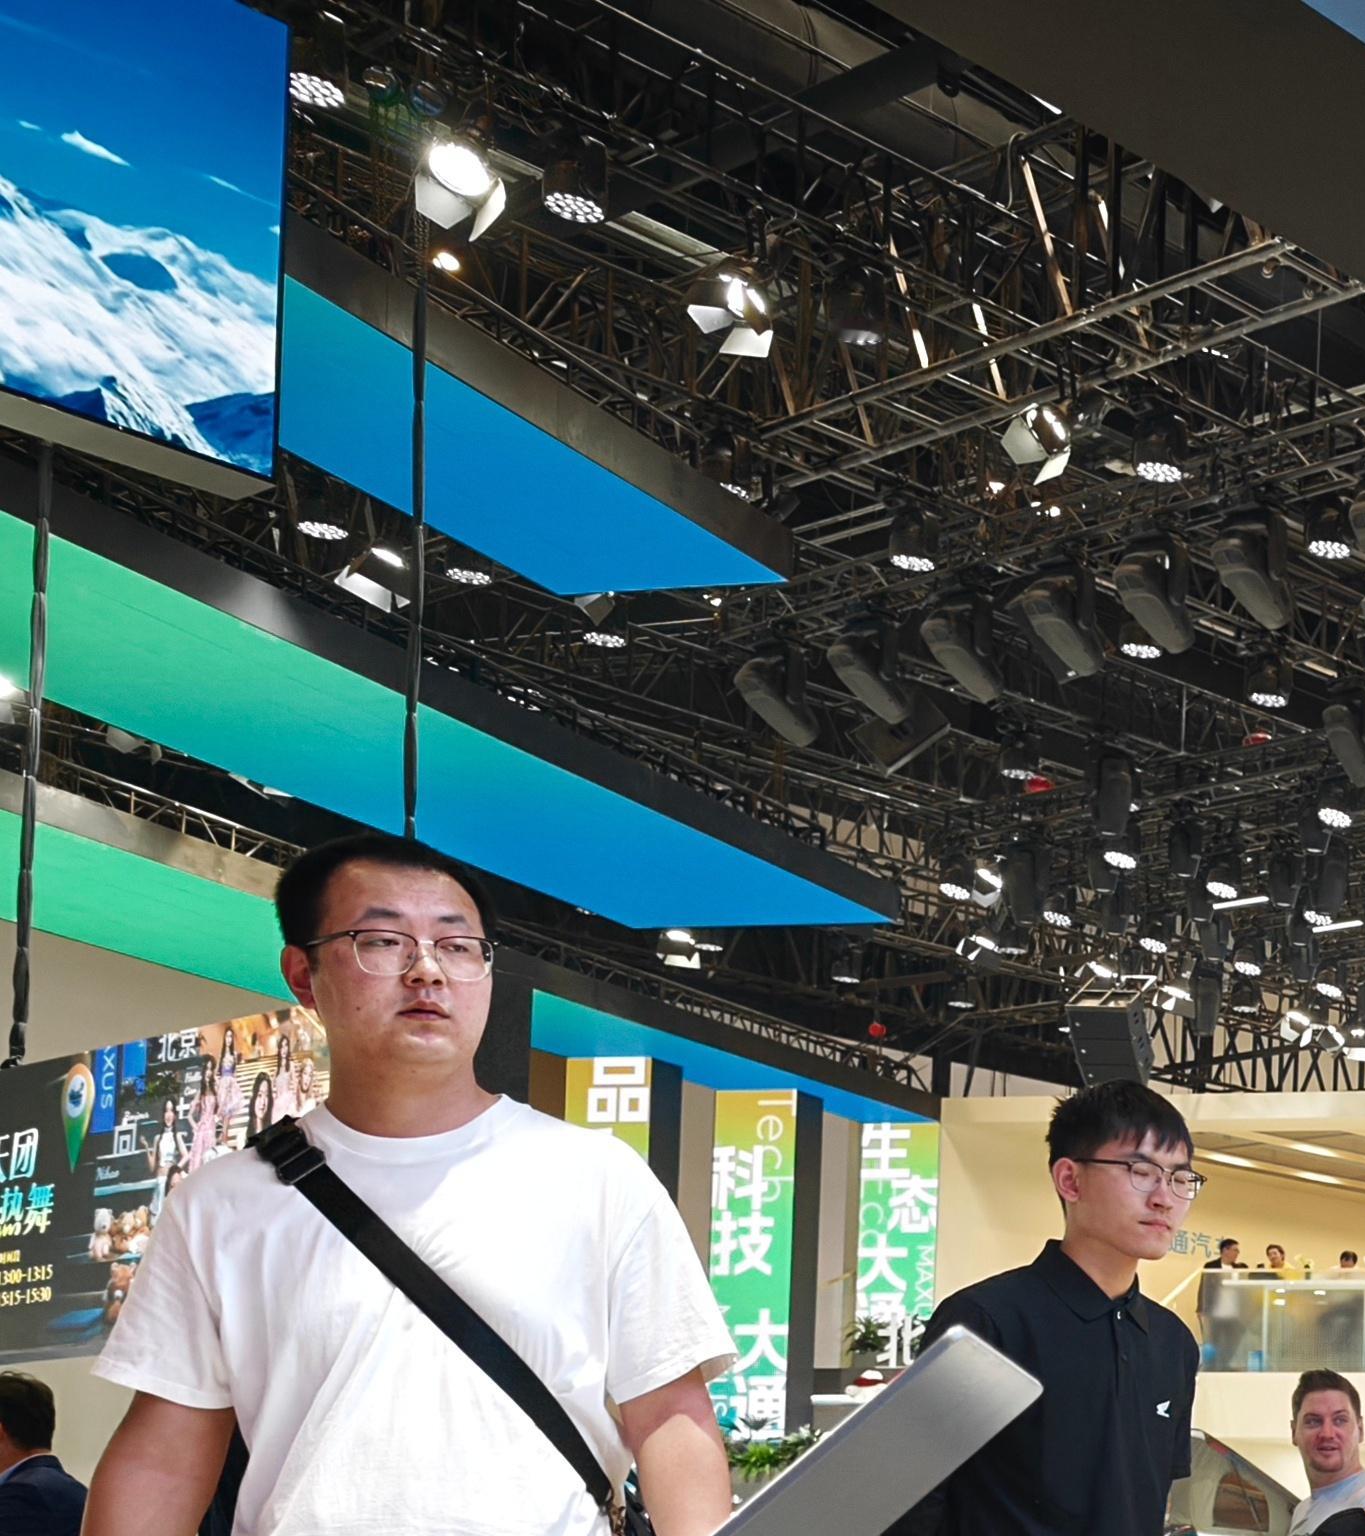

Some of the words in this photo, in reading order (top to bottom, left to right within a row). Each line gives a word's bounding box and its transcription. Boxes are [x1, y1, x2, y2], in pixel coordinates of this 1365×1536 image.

[101, 1046, 115, 1109] XUS
[158, 1029, 198, 1062] 北京
[586, 1056, 650, 1134] 品
[711, 1145, 775, 1277] 科技
[859, 1122, 938, 1234] 生态
[914, 1245, 934, 1322] MAXU
